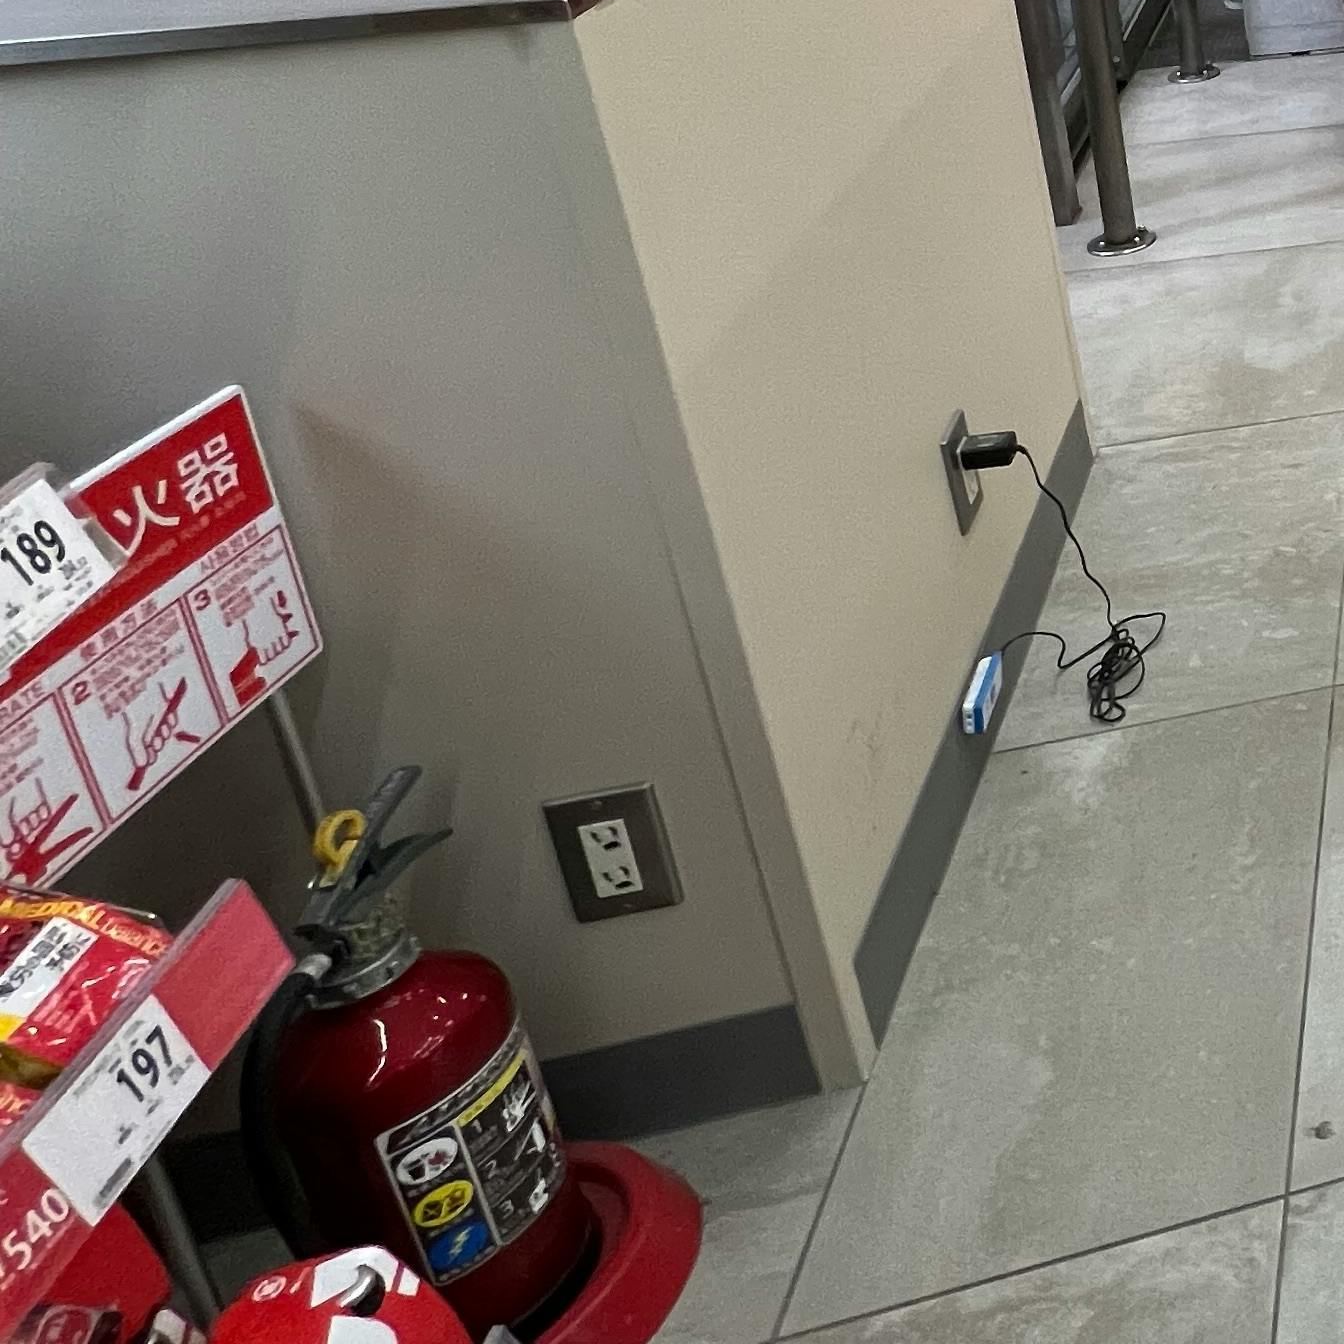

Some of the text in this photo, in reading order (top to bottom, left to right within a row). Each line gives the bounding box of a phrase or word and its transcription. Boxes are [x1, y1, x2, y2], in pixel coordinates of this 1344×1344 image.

[112, 432, 240, 557] 火器
[0, 520, 66, 587] 189
[71, 680, 92, 707] 2
[116, 1026, 176, 1105] 197
